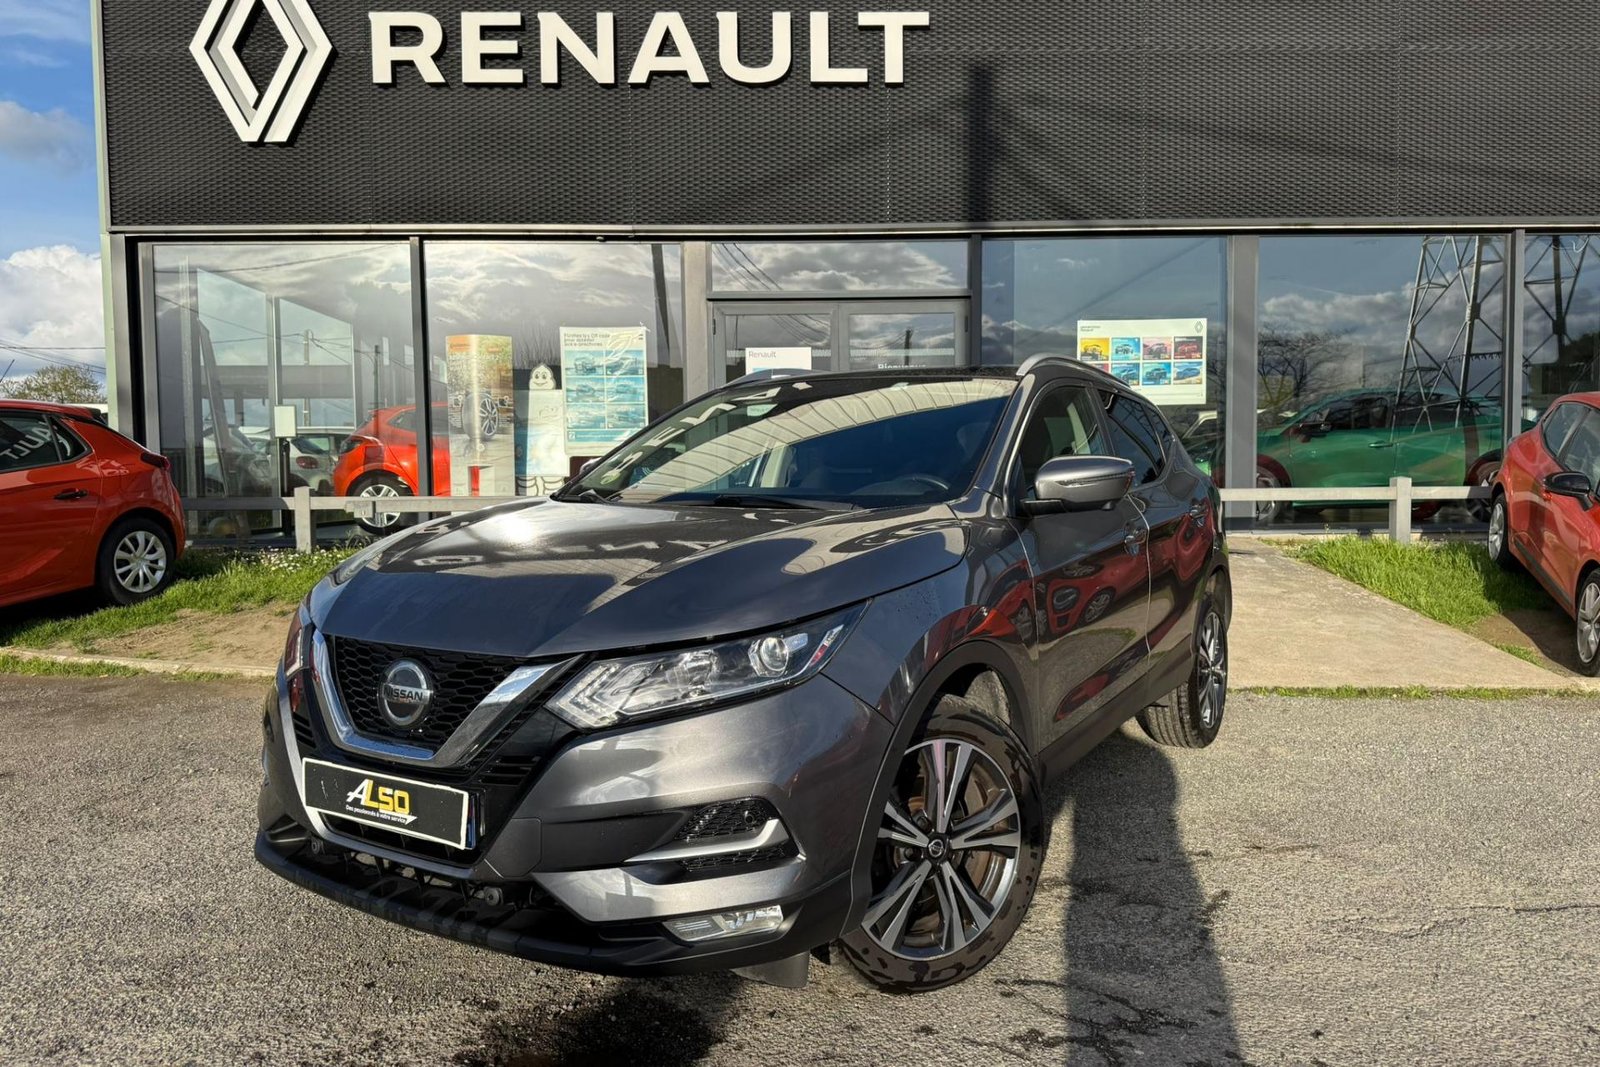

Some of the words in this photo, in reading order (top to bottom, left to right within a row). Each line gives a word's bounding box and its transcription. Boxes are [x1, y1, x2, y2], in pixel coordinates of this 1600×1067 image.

[368, 10, 930, 85] RENAULT
[748, 350, 777, 359] Renault
[383, 685, 423, 702] NISSAN
[346, 778, 410, 815] ALSO
